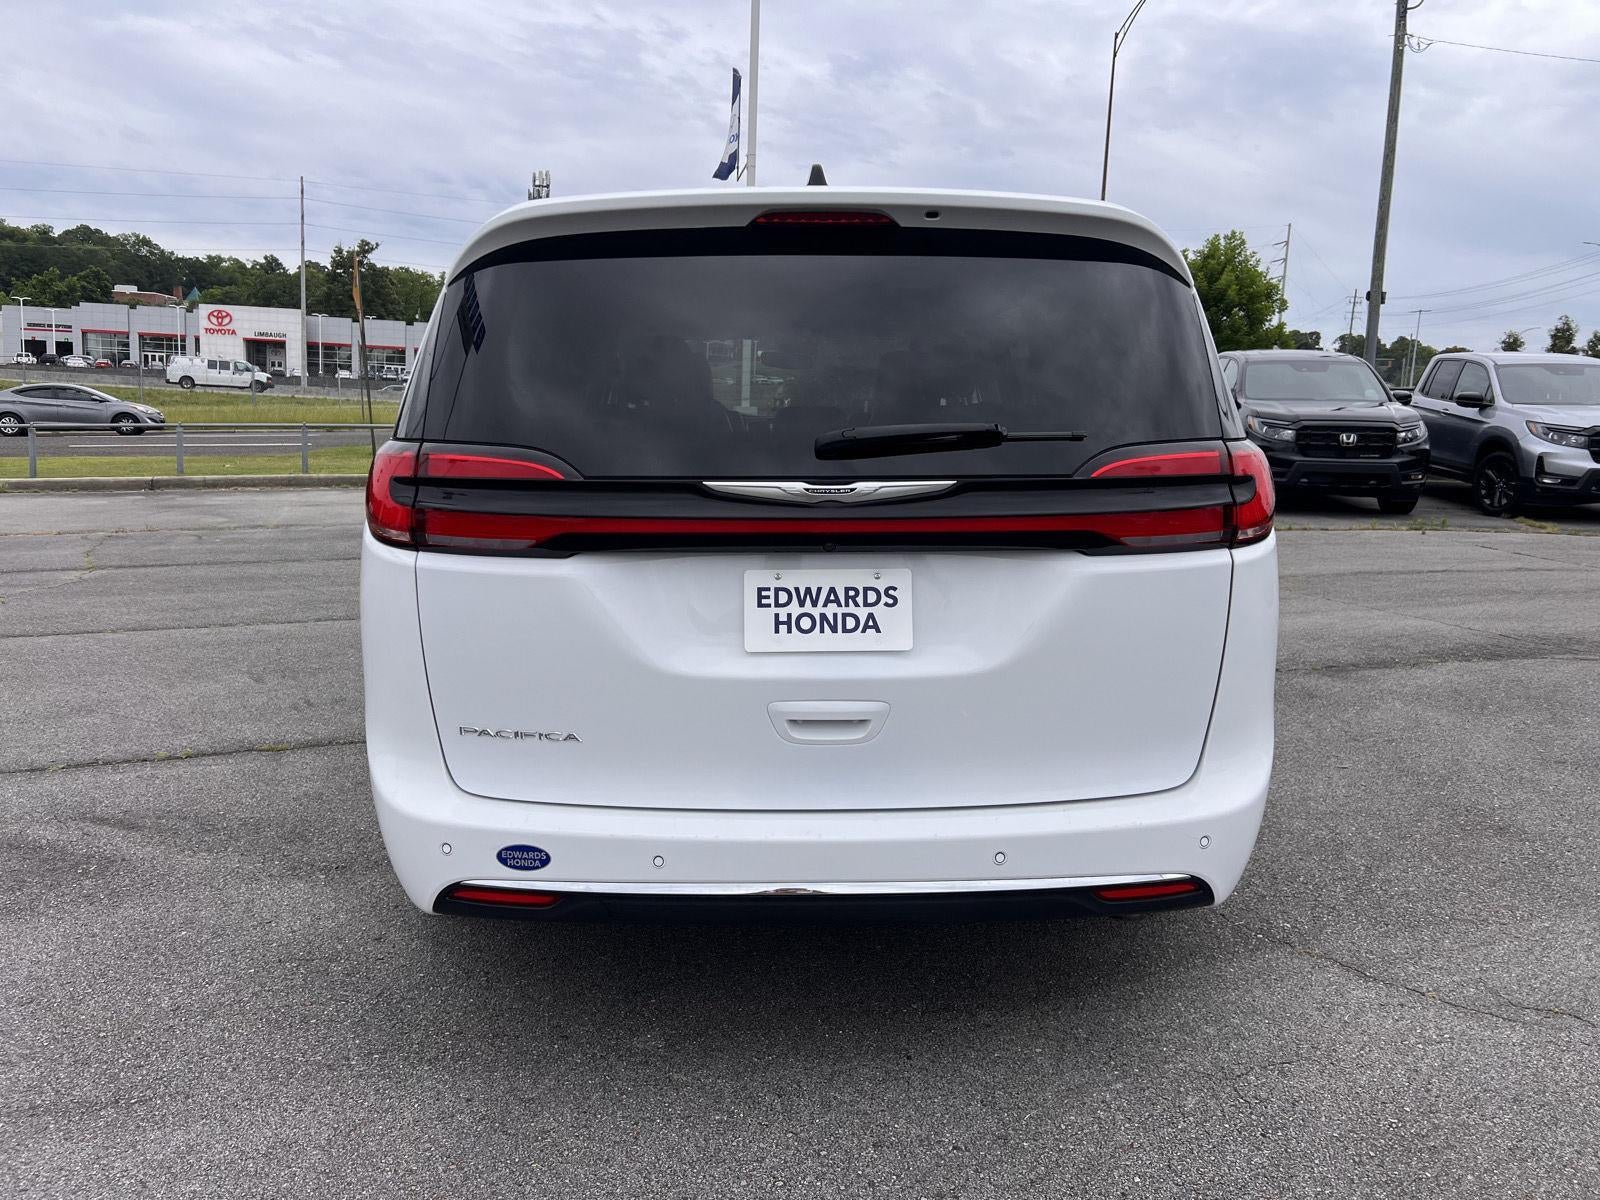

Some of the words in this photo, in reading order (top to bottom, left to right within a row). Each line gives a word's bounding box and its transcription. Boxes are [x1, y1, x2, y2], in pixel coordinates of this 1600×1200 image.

[203, 327, 237, 336] TOYOTA
[756, 586, 899, 608] EDWARDS
[774, 612, 882, 634] HONDA
[458, 726, 583, 743] PACIFICA
[501, 850, 547, 860] EDWARDS
[507, 859, 541, 868] HONDA
